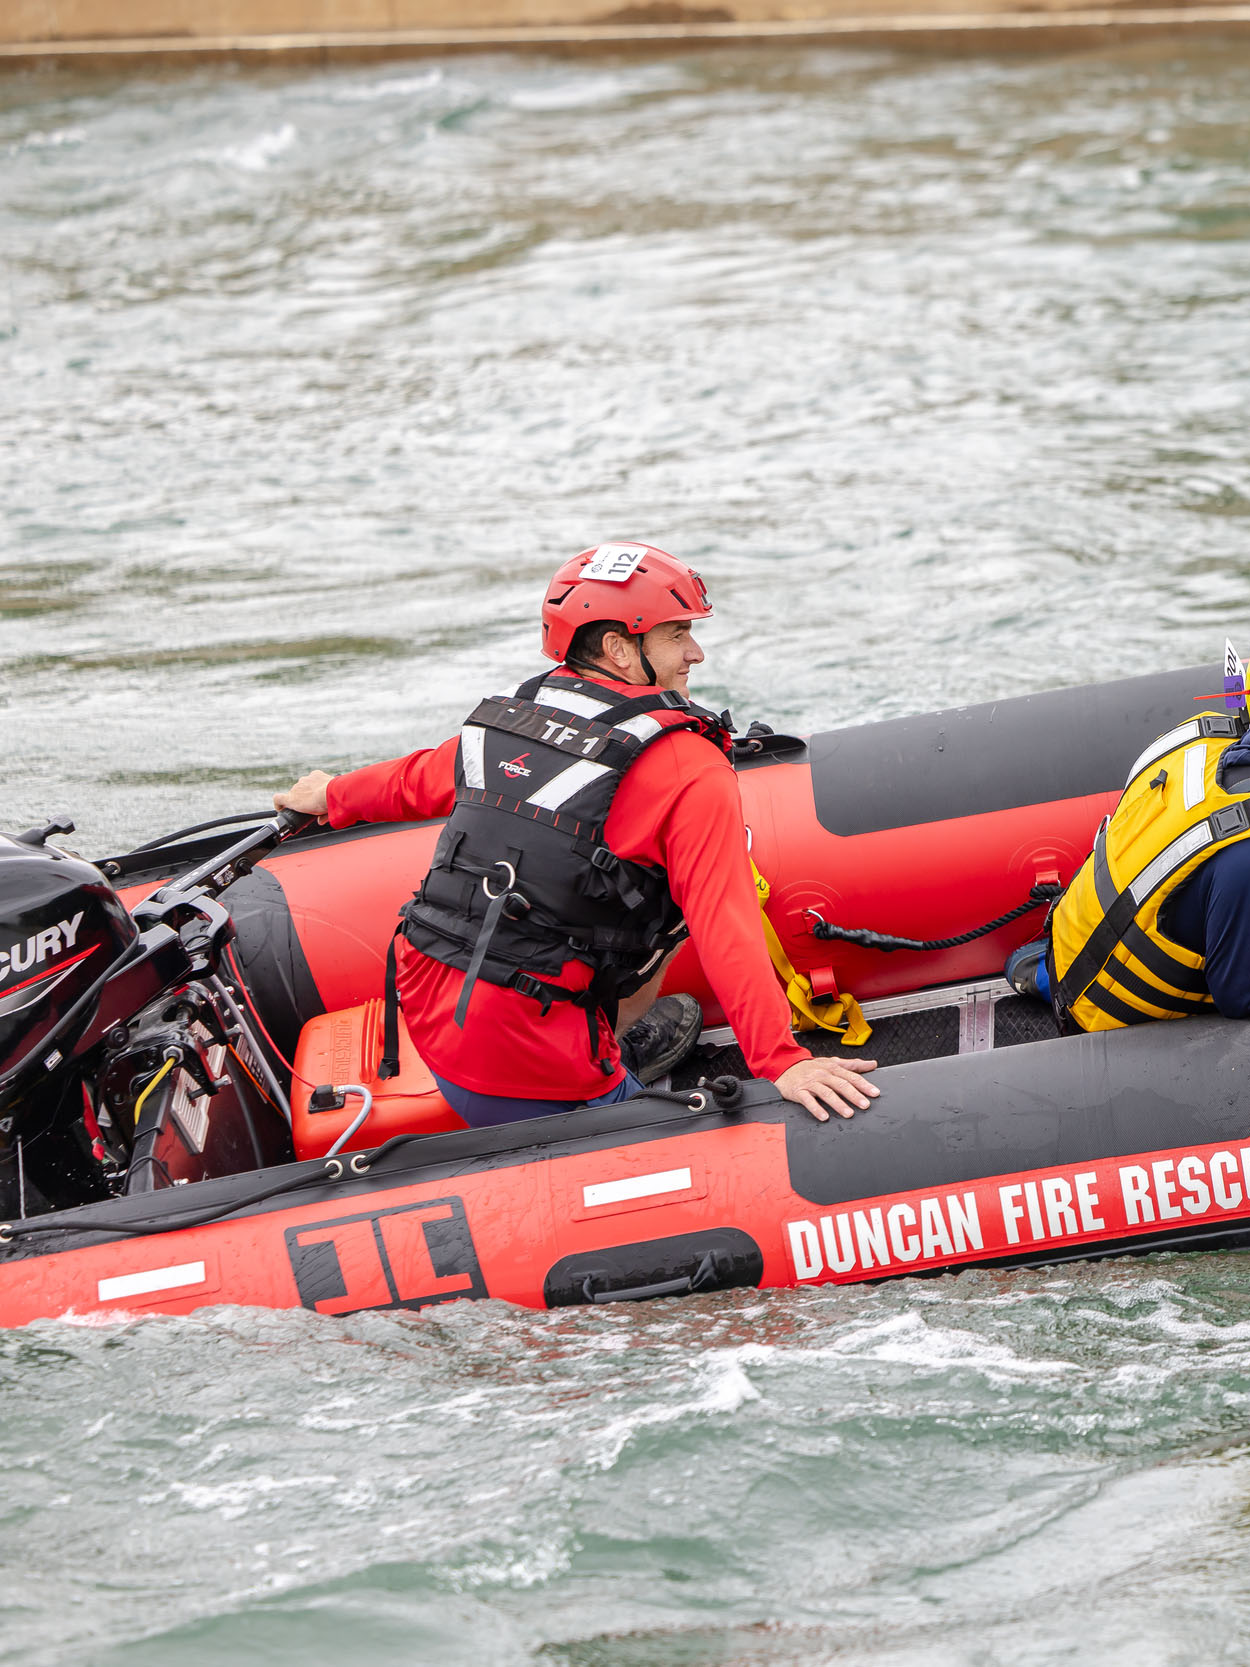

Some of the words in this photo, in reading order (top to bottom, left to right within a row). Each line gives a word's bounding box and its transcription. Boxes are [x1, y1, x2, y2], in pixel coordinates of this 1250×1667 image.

[608, 553, 638, 574] 112
[541, 719, 580, 746] TF
[581, 737, 600, 755] 1
[498, 761, 532, 777] FORCE
[787, 1191, 985, 1280] DUNCAN
[998, 1171, 1105, 1244] FIRE
